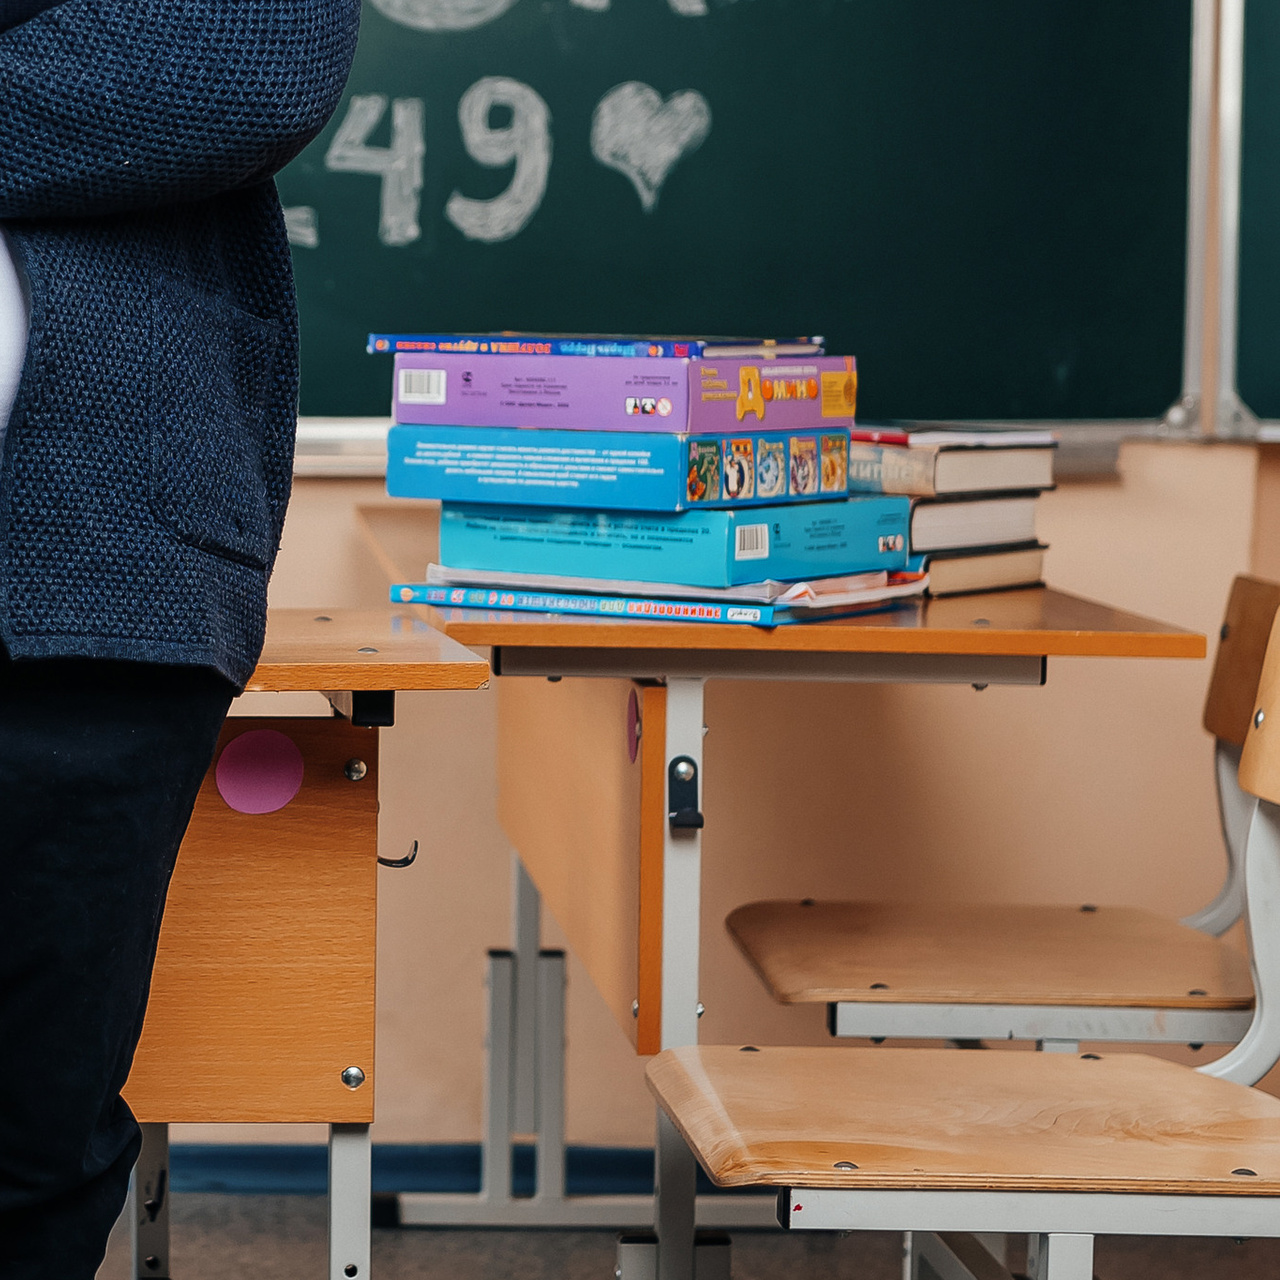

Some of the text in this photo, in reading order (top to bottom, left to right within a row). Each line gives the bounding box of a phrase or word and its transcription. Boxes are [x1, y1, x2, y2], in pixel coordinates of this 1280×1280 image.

[326, 75, 553, 246] 49
[600, 600, 625, 612] ДЛЯ
[627, 602, 721, 619] ЭНЦИКЛОПЕДИЯ
